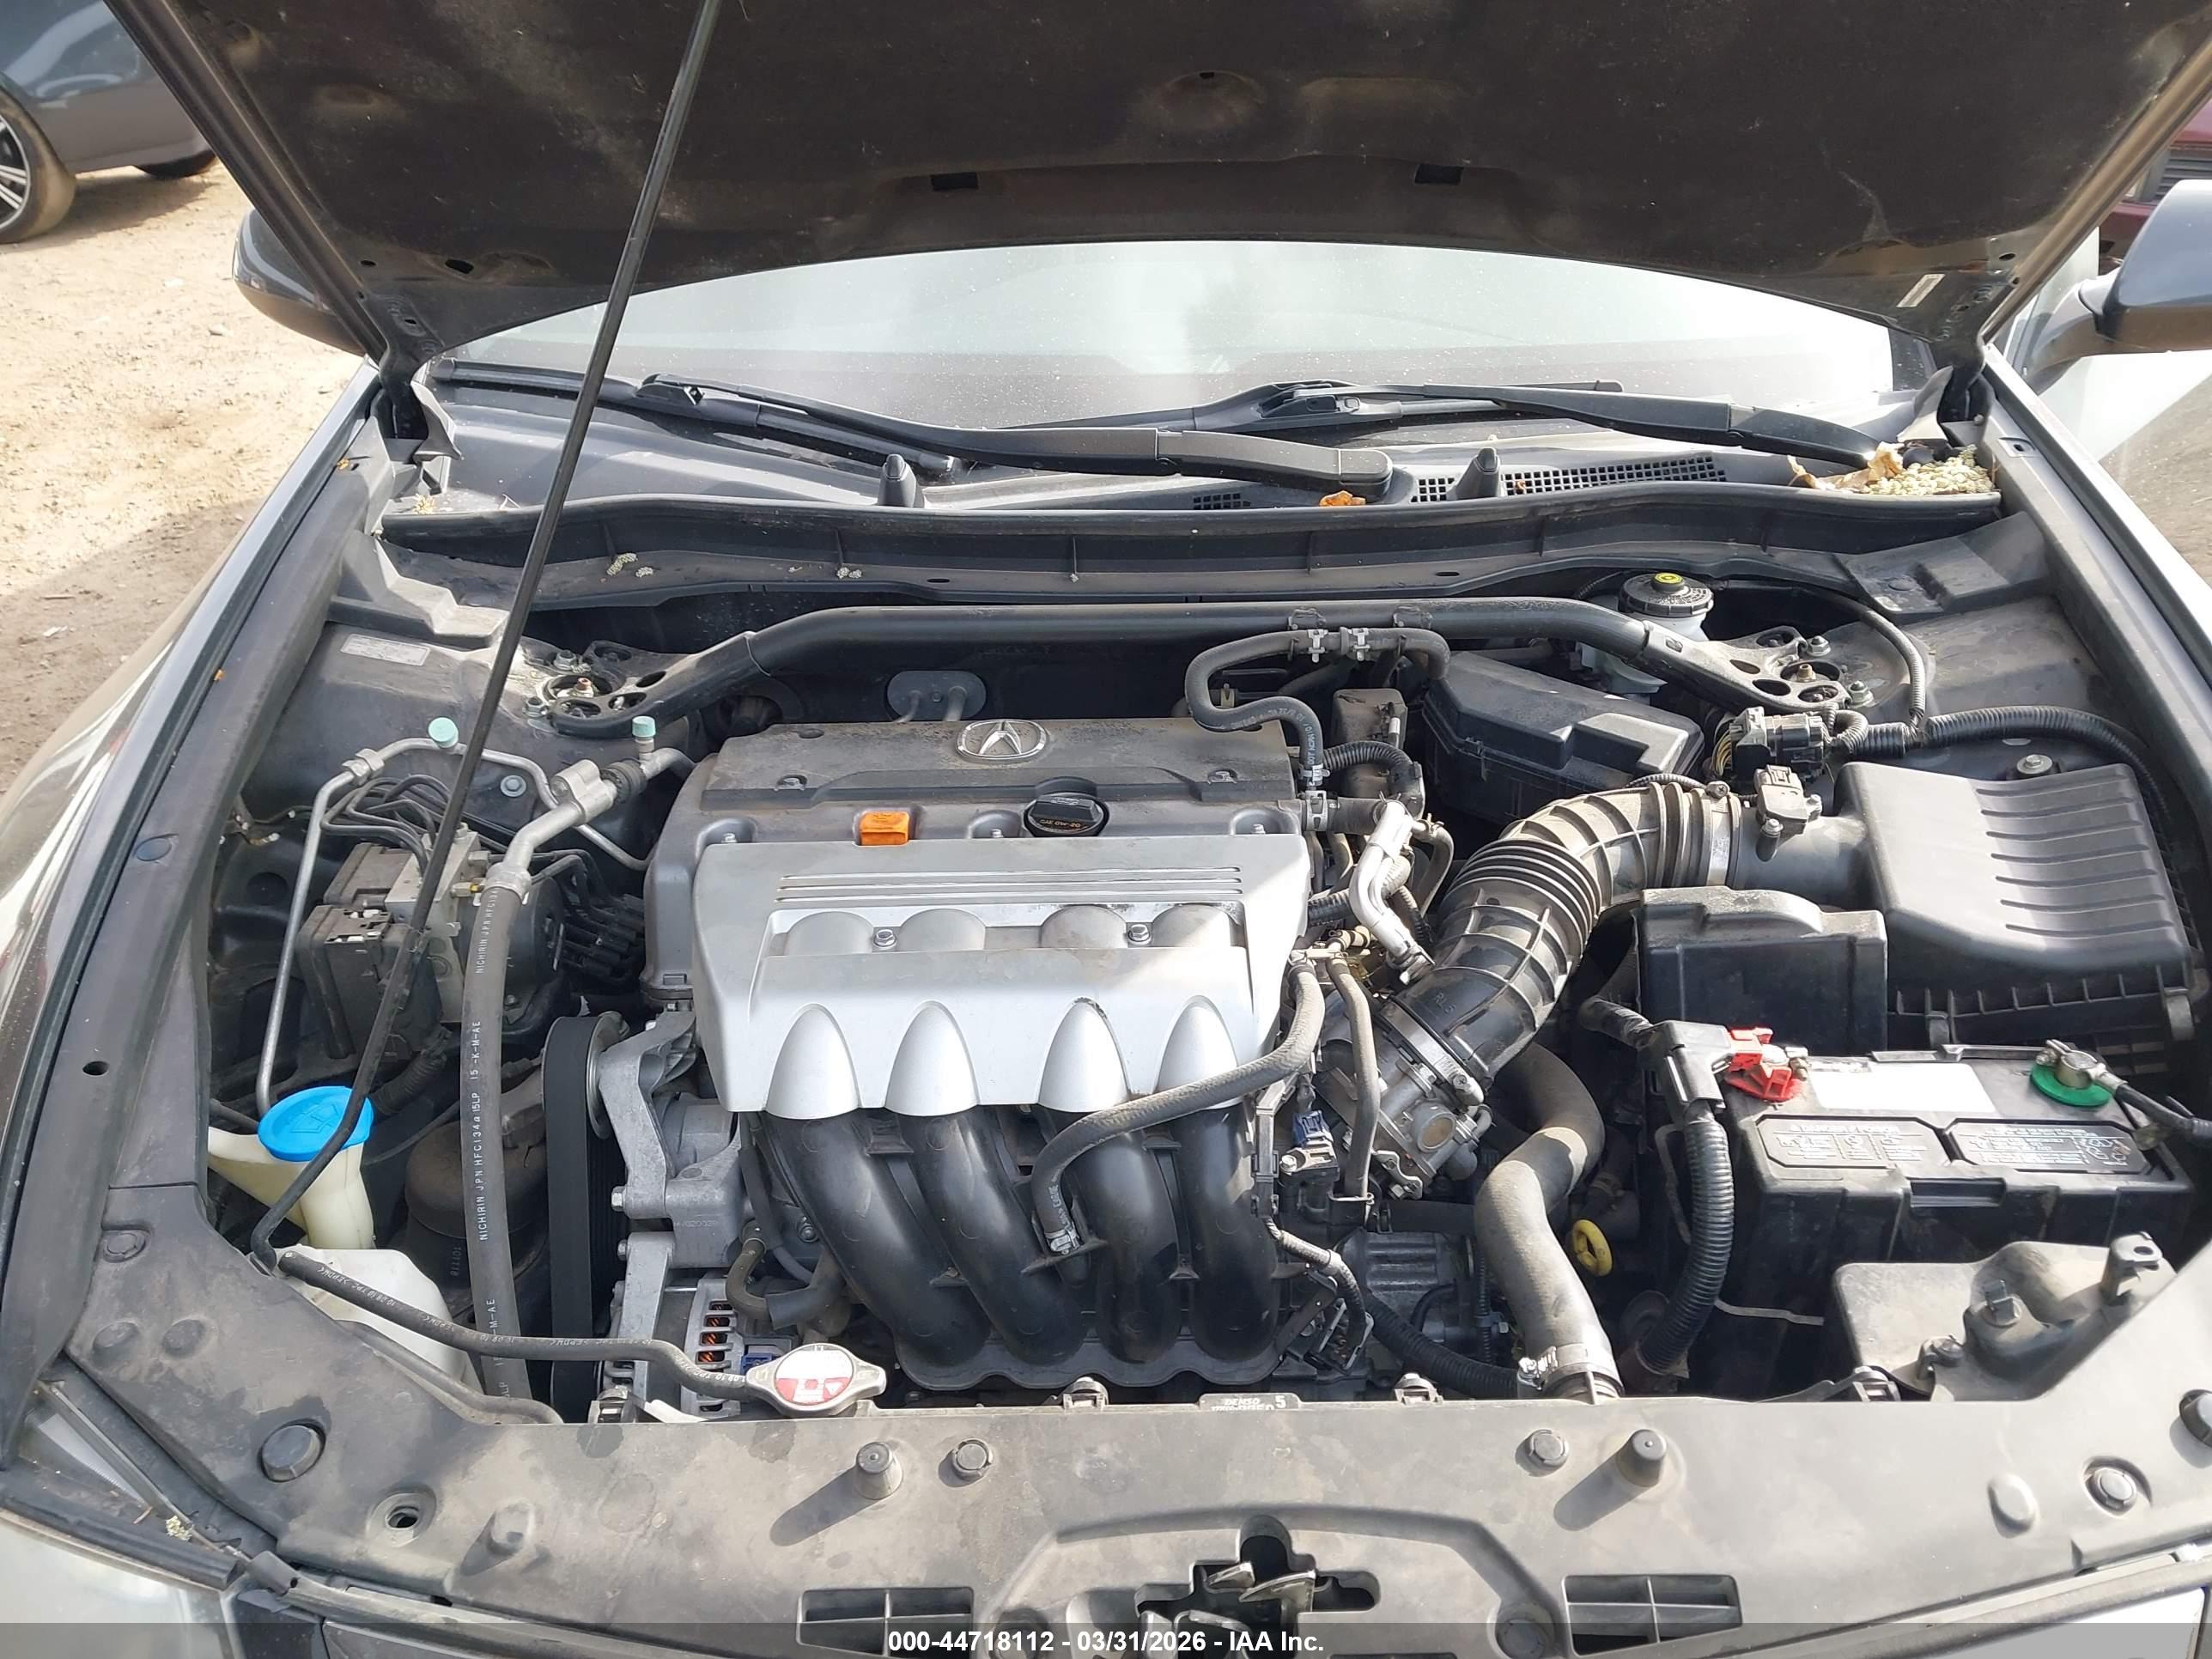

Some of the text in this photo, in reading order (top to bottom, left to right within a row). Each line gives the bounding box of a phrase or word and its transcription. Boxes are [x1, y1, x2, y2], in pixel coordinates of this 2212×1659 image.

[475, 939, 489, 974] NICHIRIN
[471, 1092, 481, 1112] 15LP
[472, 1116, 483, 1166] HFC134a
[475, 1170, 484, 1191] JPN
[476, 1196, 488, 1241] NICHIRIN
[486, 1298, 498, 1335] -M-AE
[1224, 1397, 1261, 1406] DENSO
[1275, 1395, 1287, 1408] 5
